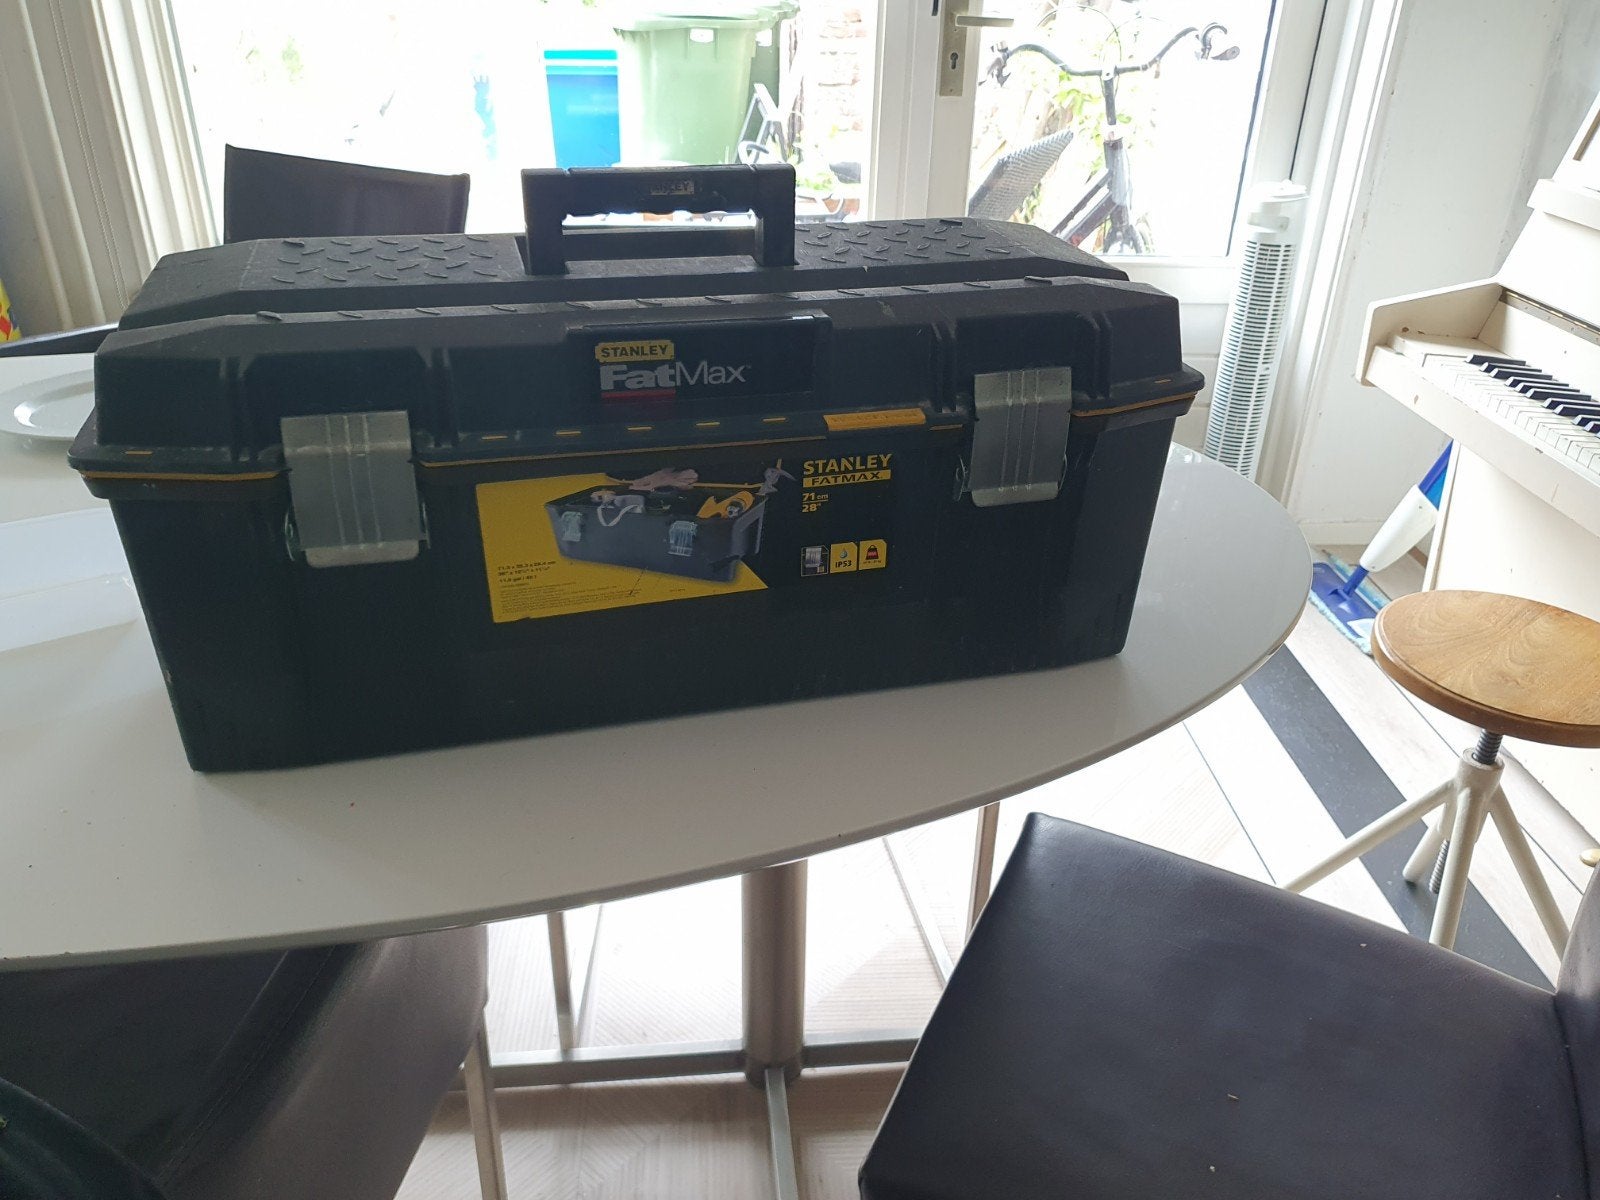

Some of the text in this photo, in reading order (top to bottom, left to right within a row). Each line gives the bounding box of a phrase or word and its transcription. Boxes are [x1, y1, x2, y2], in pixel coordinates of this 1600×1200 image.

[600, 344, 669, 359] STANLEY
[803, 453, 893, 475] STANLEY
[811, 471, 881, 486] FATMAX
[802, 492, 815, 502] 71
[835, 560, 852, 569] IP53
